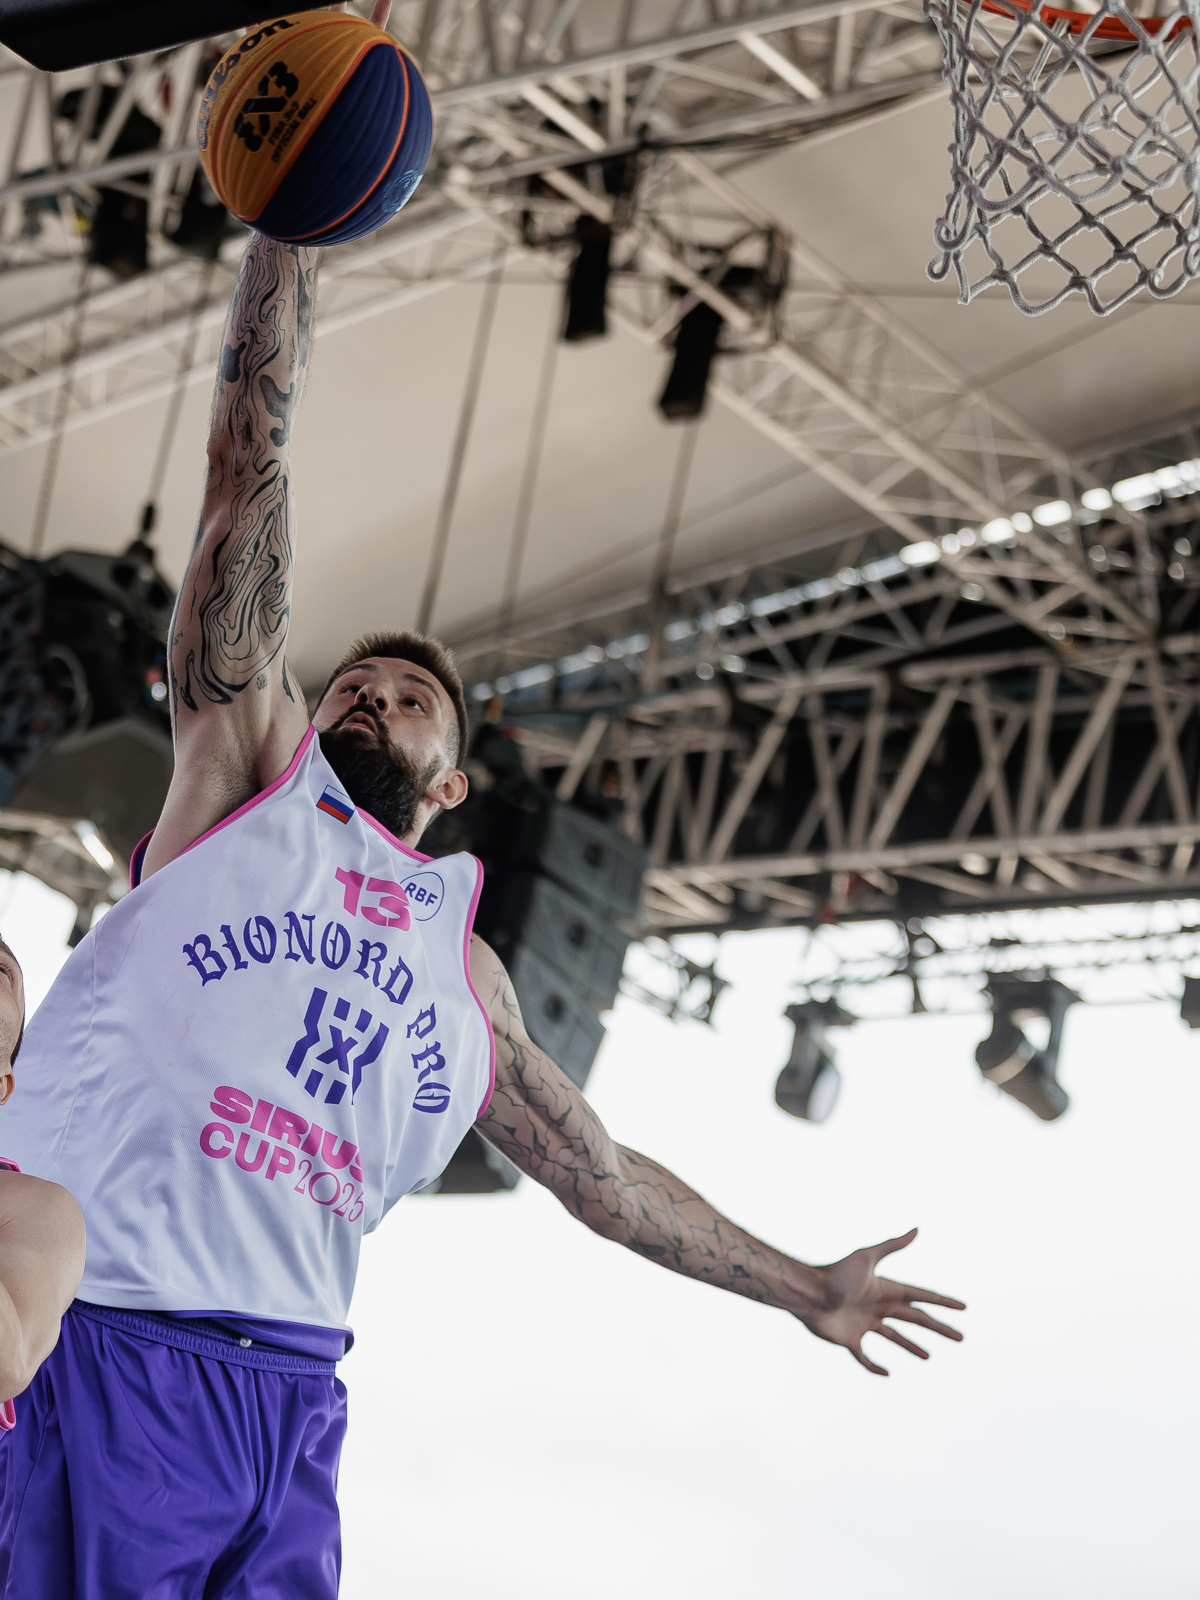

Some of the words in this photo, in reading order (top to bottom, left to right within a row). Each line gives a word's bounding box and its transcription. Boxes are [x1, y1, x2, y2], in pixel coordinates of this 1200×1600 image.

[268, 121, 286, 146] FIBA
[271, 120, 301, 163] OFFICIAL
[297, 97, 318, 120] BALL
[335, 866, 411, 932] 13
[404, 881, 439, 907] RBF
[182, 910, 414, 1006] BIONORD
[406, 1002, 452, 1114] PRO
[199, 1121, 297, 1182] CUP
[293, 1159, 365, 1223] 2025
